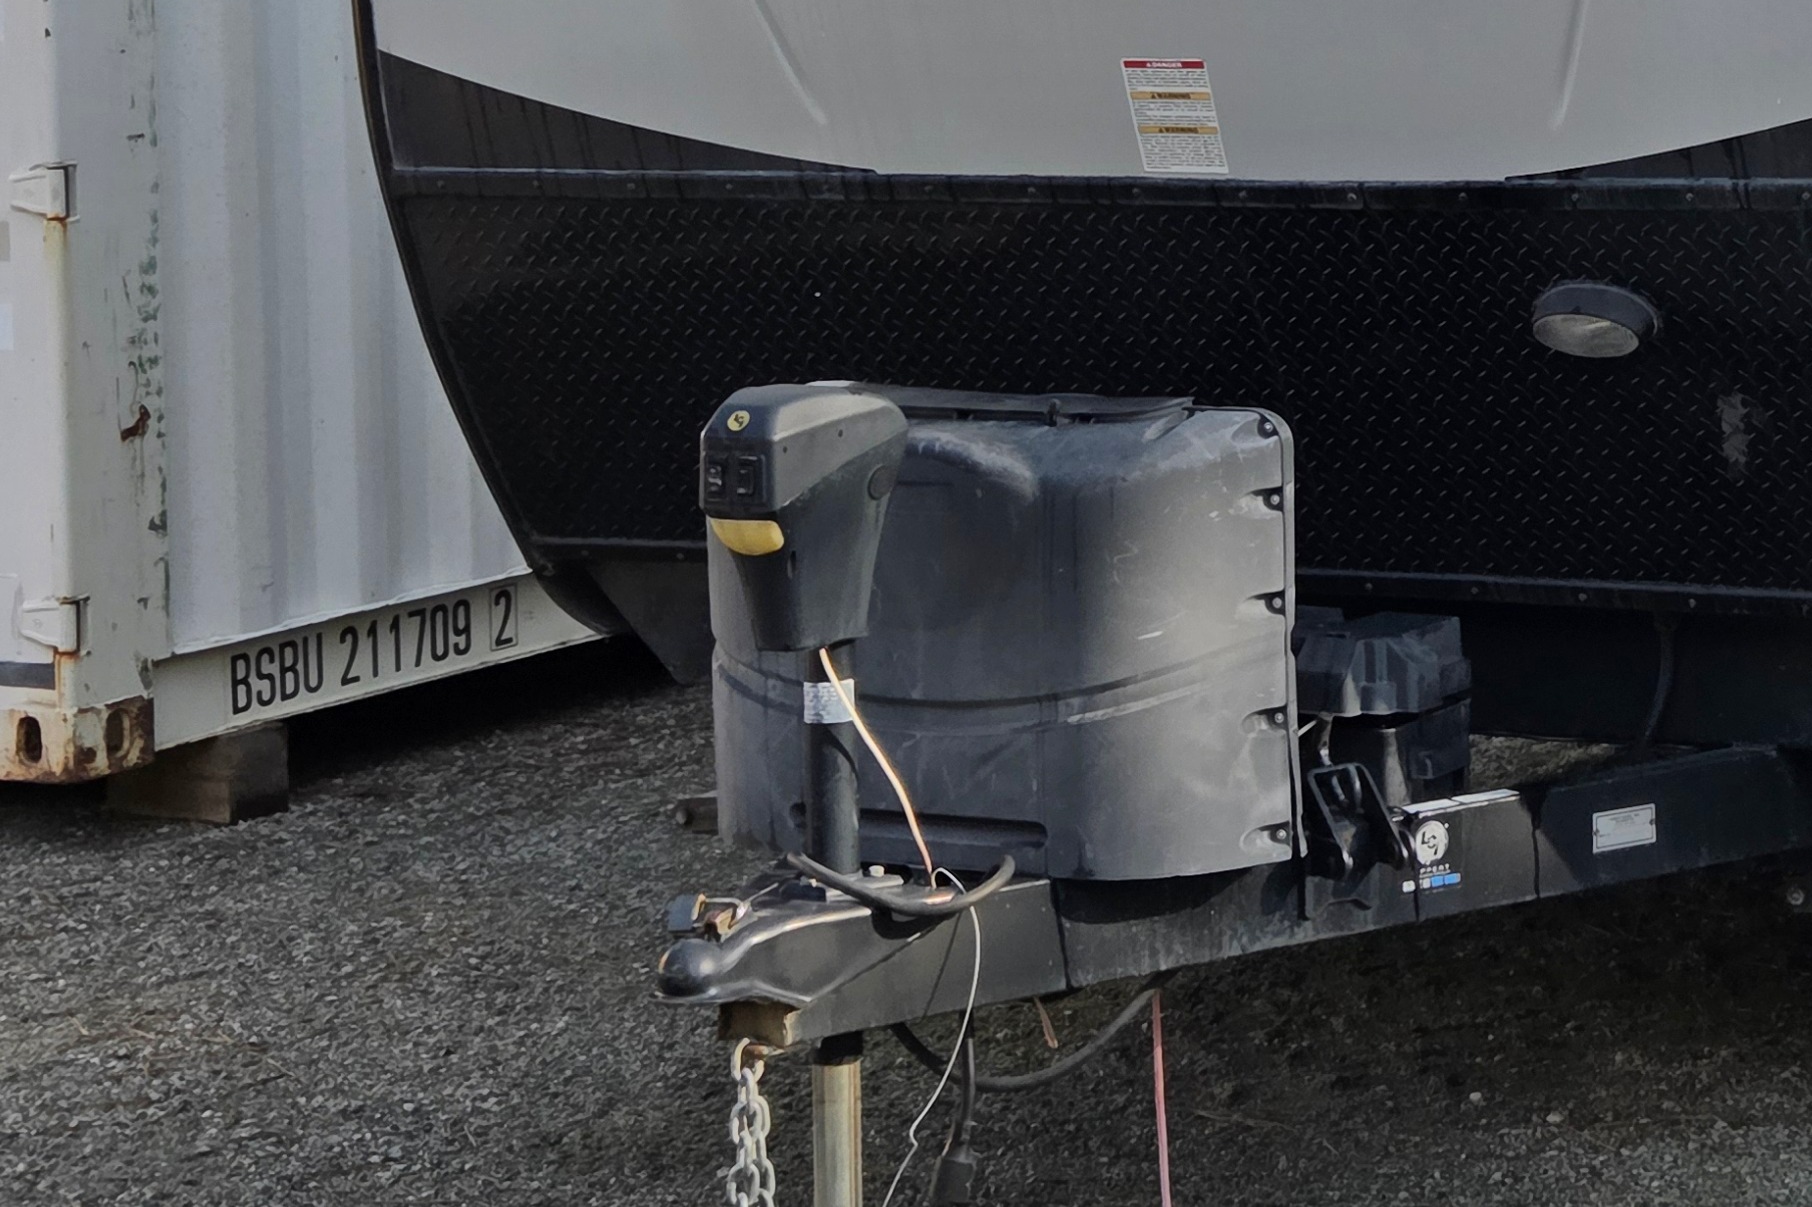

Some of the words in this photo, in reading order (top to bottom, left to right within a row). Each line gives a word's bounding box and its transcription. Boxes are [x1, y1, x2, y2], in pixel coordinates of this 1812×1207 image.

[230, 632, 324, 716] BSBU
[339, 598, 472, 687] 211709
[494, 588, 514, 648] 2
